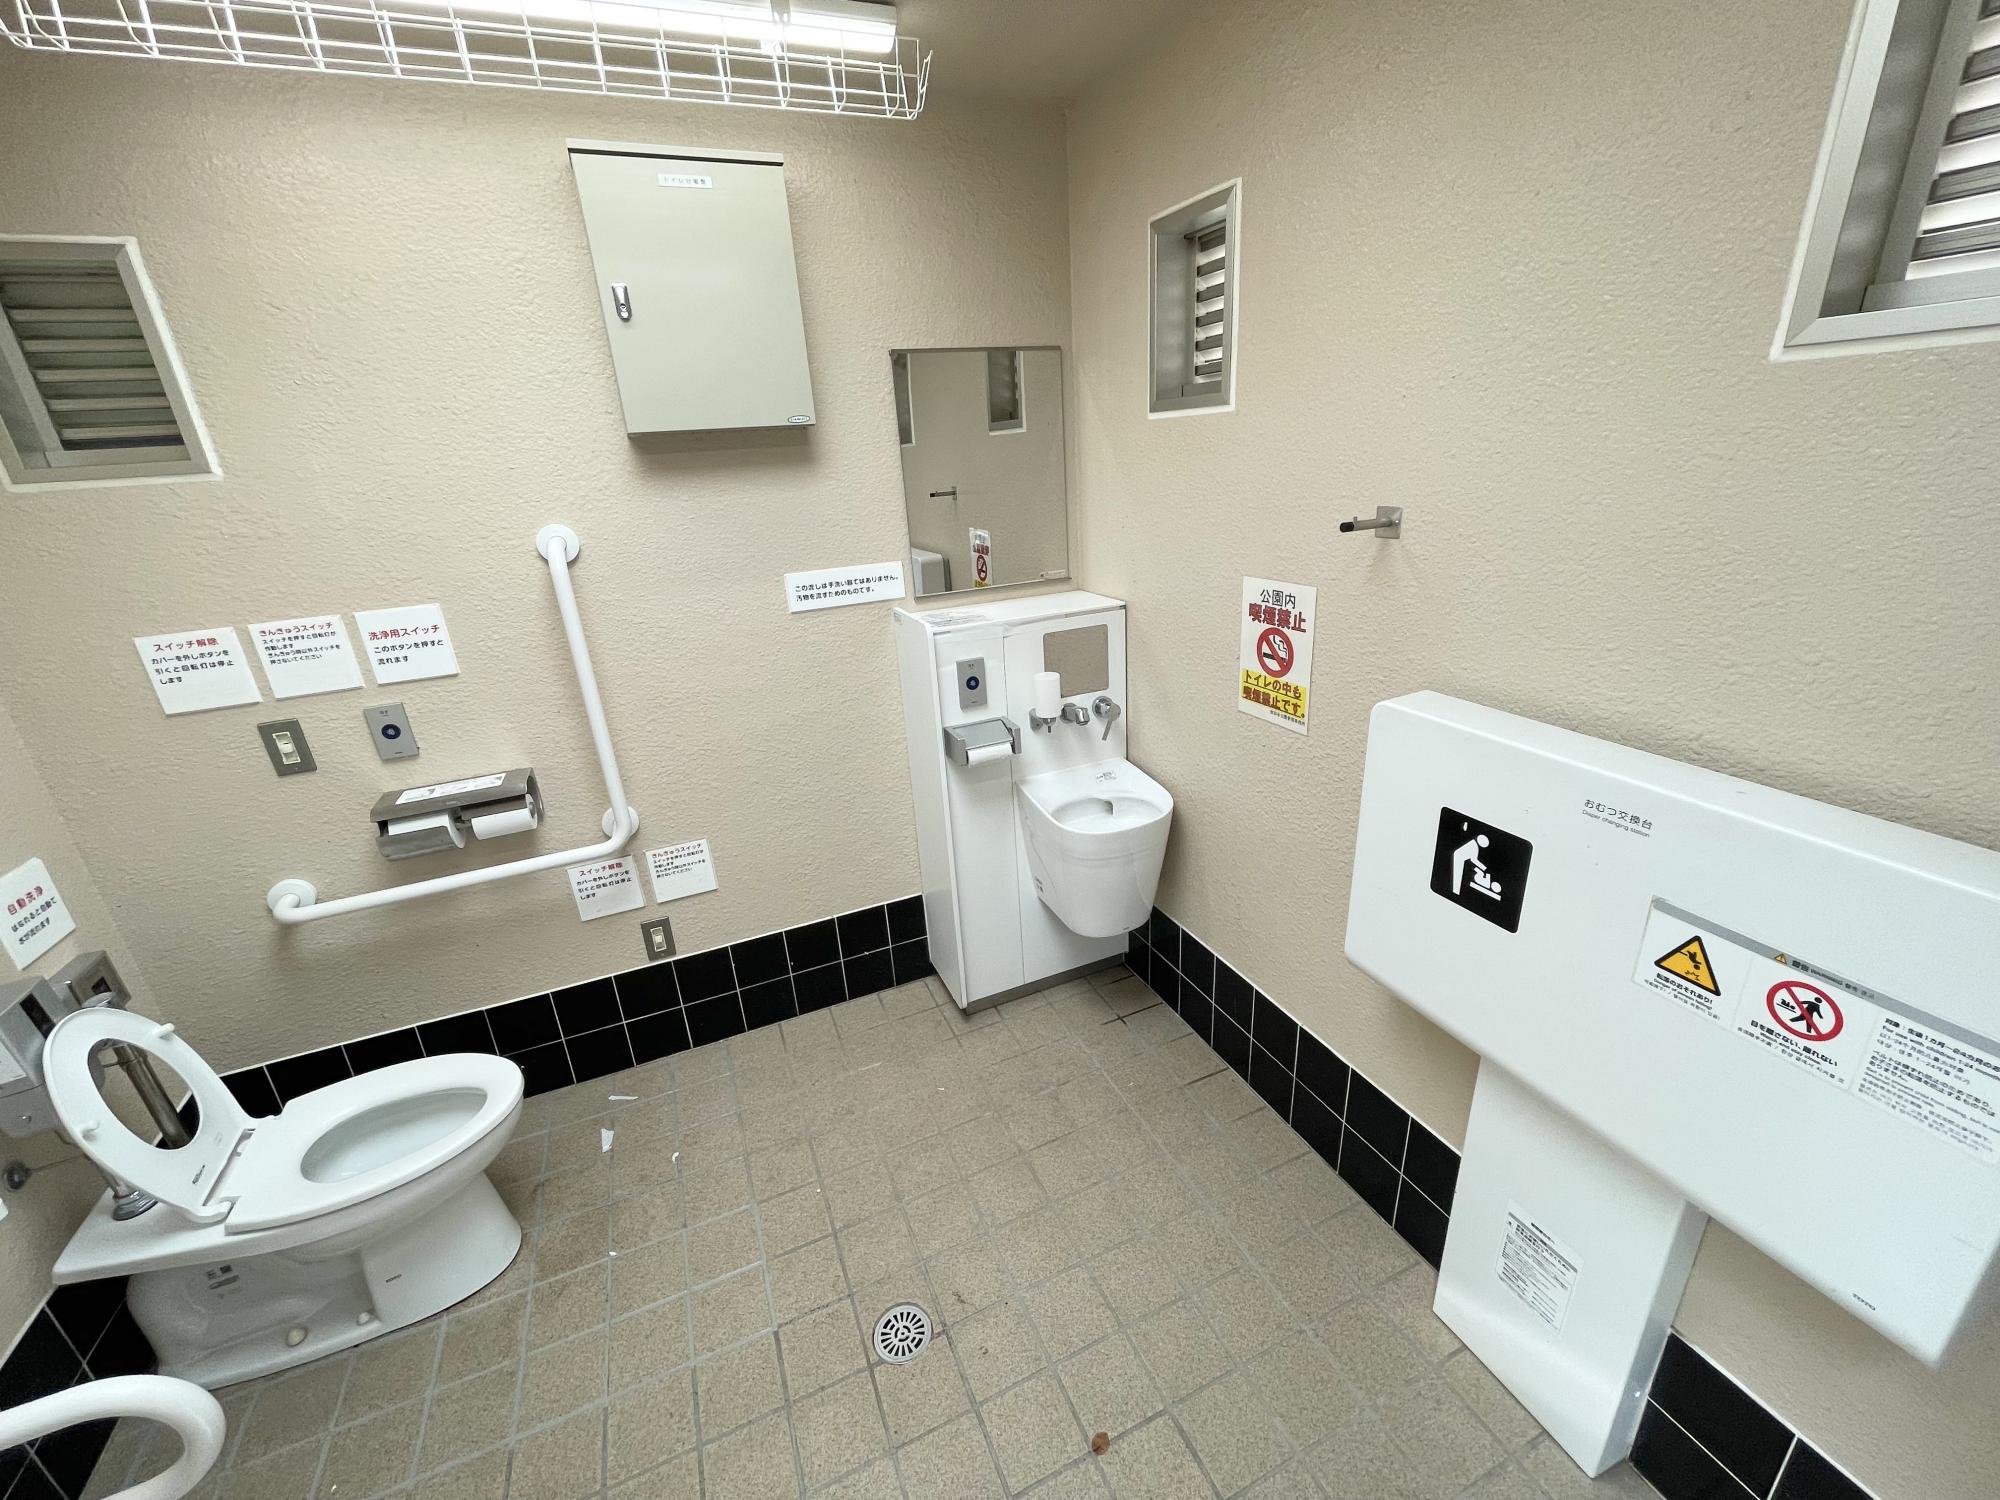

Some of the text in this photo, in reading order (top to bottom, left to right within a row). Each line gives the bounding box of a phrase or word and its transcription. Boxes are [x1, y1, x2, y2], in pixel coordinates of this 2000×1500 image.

[1260, 589, 1296, 609] 公園内
[1249, 603, 1306, 632] 喫煙禁止
[259, 622, 332, 637] きんきゅうスイッチ
[368, 624, 440, 640] 洗浄用スイッチ
[153, 637, 219, 652] スイッチ解除
[373, 640, 444, 654] このボタンを押すと
[377, 655, 409, 665] 流れます
[160, 676, 183, 685] します
[1246, 669, 1301, 699] トイレの中も
[1243, 685, 1305, 718] 喫煙禁止です。
[1584, 799, 1653, 830] おむつ交換台
[1601, 817, 1629, 831] changing
